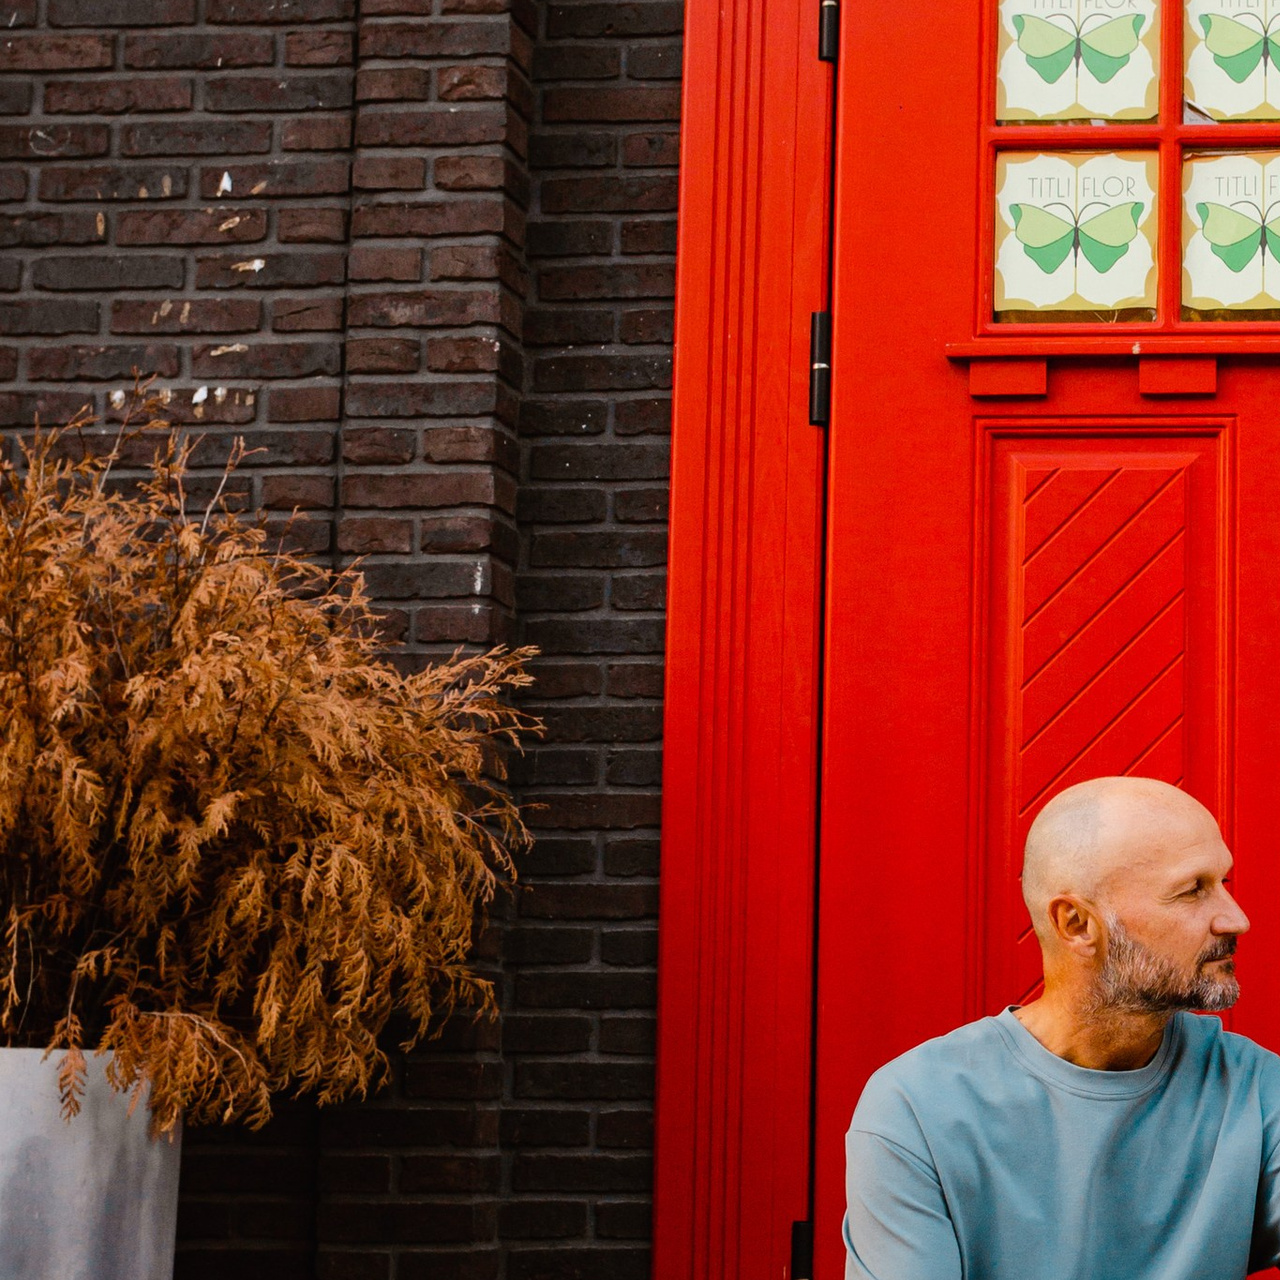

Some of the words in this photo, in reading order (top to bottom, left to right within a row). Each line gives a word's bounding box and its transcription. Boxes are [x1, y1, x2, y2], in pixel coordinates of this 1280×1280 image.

[1027, 176, 1071, 198] TITLI
[1082, 175, 1136, 197] FLOR
[1214, 175, 1258, 197] TITLI
